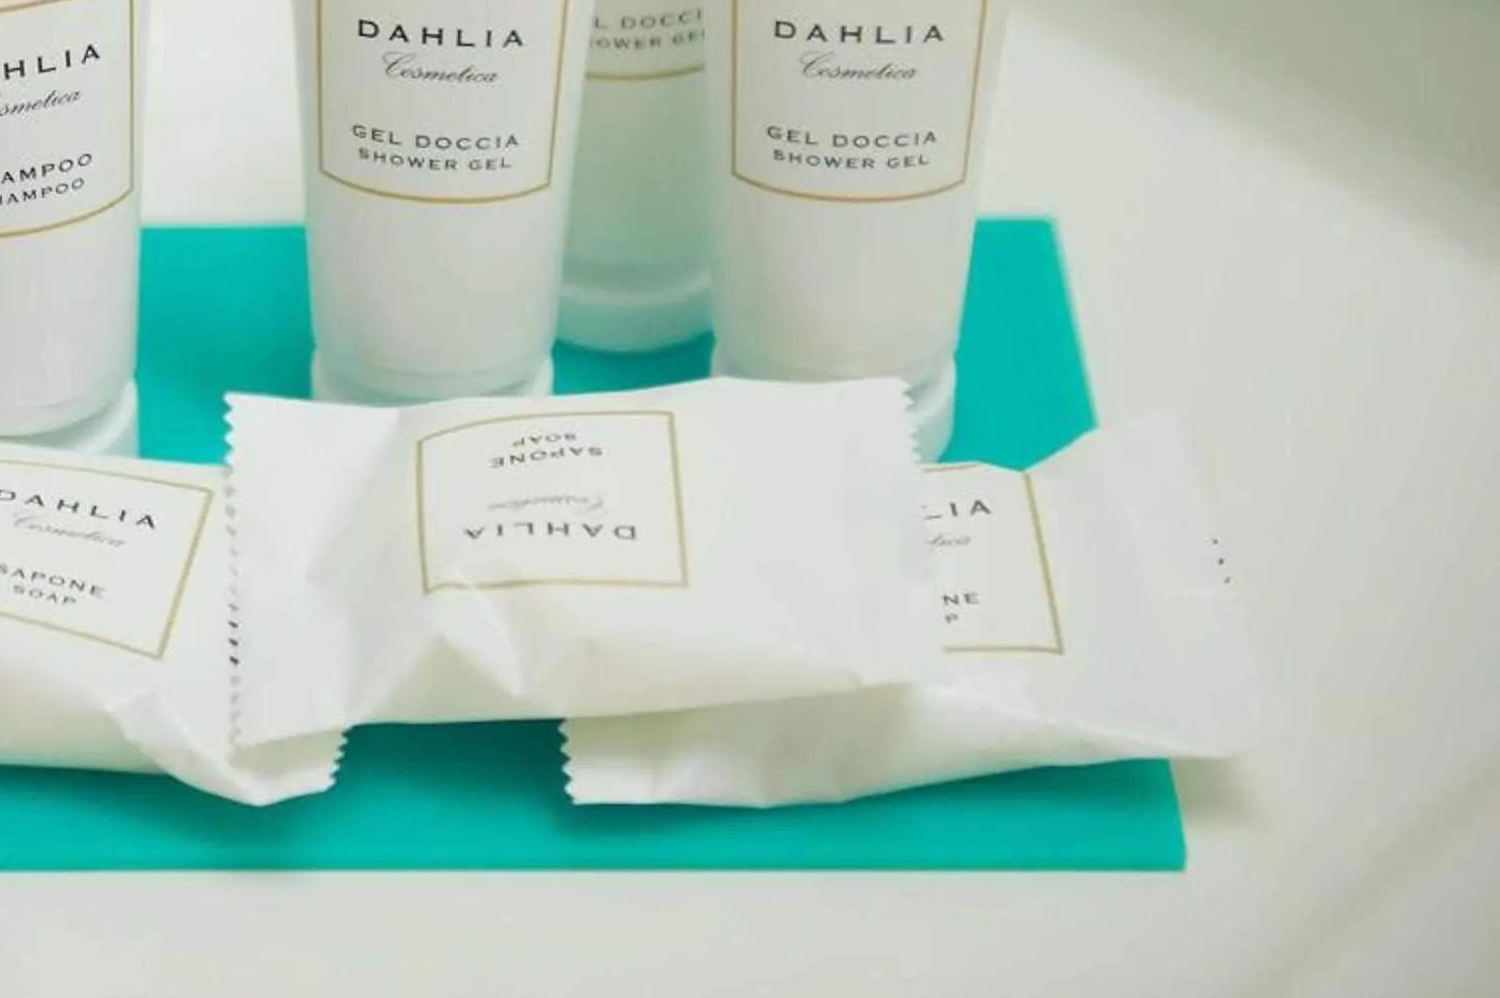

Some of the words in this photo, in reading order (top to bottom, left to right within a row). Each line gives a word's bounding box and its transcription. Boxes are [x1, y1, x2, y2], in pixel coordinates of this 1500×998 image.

[620, 8, 702, 30] DOCCI
[357, 19, 524, 48] DAHLIA
[589, 36, 661, 51] OWER
[774, 20, 944, 44] DAHLIA
[382, 51, 499, 83] Cosmetica
[800, 51, 917, 80] Cosmetica
[352, 125, 401, 145] GEL
[415, 134, 519, 150] DOCCIA
[767, 126, 818, 145] GEL
[832, 131, 937, 149] DOCCIA
[358, 148, 457, 170] SHOWER
[469, 158, 512, 171] GEL
[774, 149, 875, 169] SHOWER
[887, 155, 930, 169] GEL
[511, 431, 579, 448] SOAP
[489, 446, 604, 469] SAPONE
[463, 521, 638, 541] DAHLIA
[13, 584, 77, 605] SOAP
